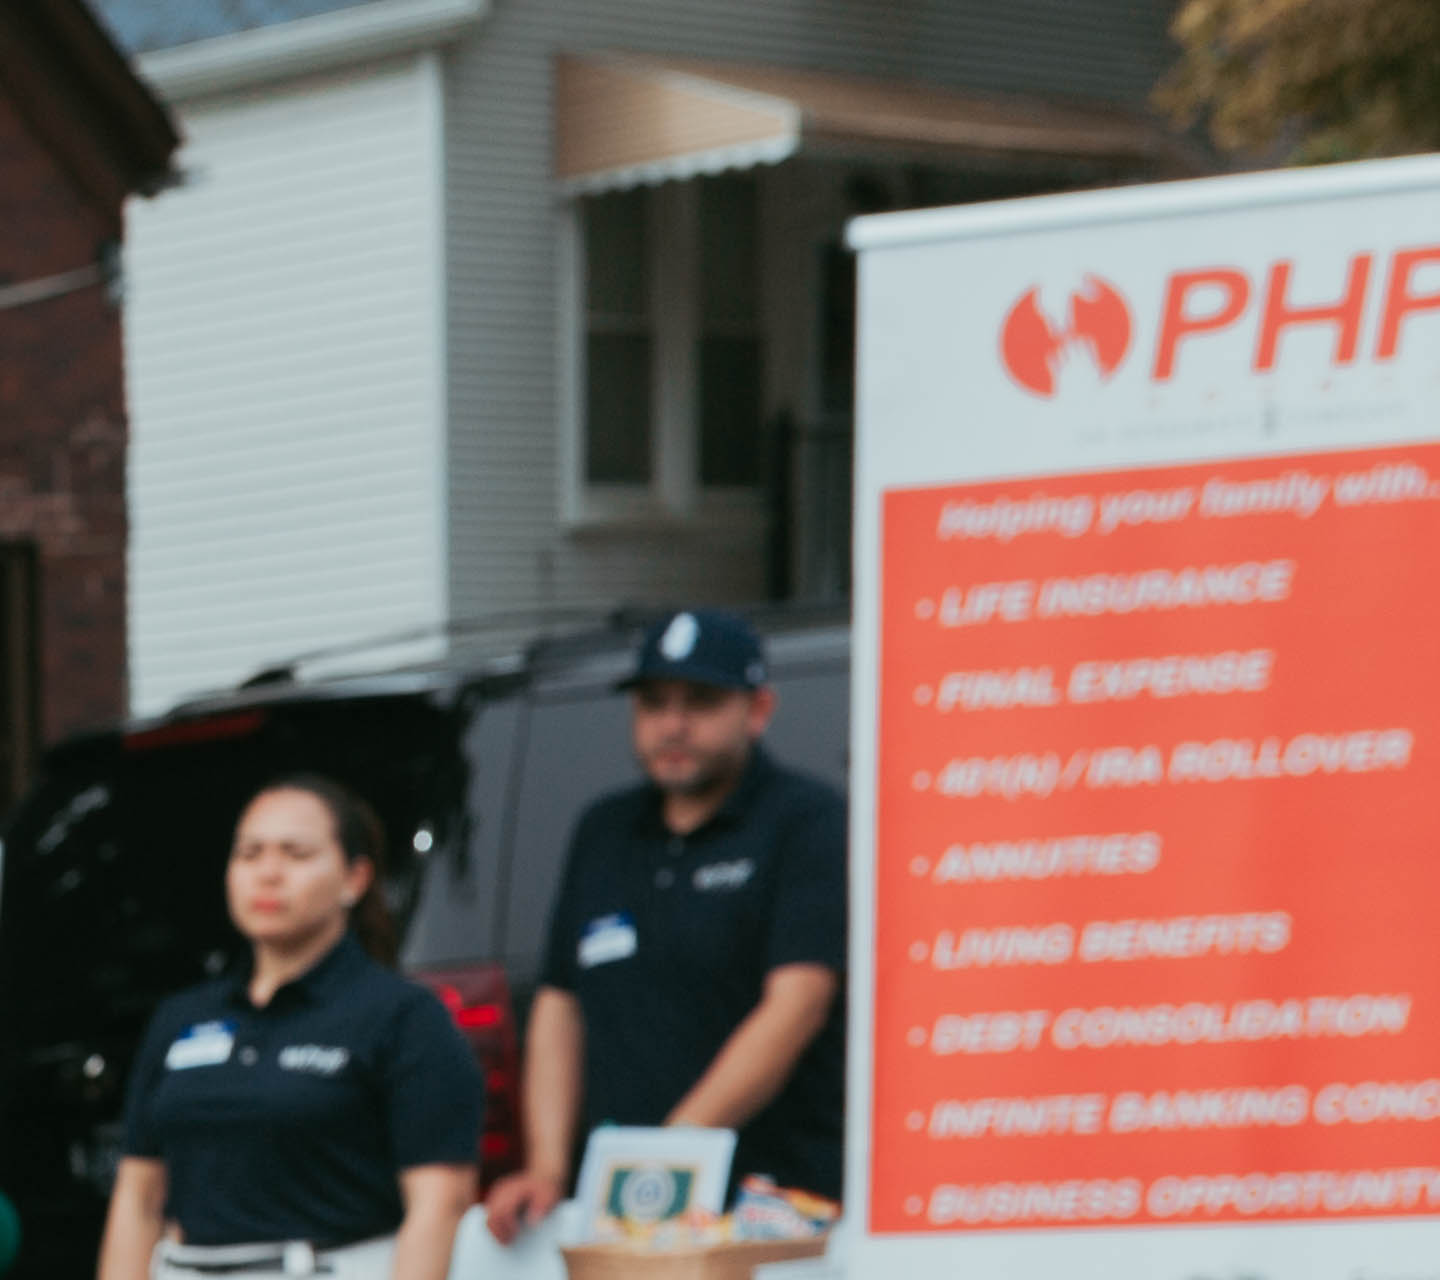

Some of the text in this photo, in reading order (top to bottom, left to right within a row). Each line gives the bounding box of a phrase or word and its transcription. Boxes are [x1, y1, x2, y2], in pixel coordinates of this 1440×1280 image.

[937, 464, 1328, 541] Helping your family
[937, 558, 1296, 628] LIFE INSURANCE
[935, 648, 1276, 714] FINAL EXPENSE
[1087, 745, 1163, 789] IRA
[1169, 727, 1414, 785] ROLLOVER
[933, 831, 1162, 884] ANNUITIES
[932, 910, 1292, 971] LIVING BENEFITS
[931, 993, 1413, 1056] DEBT CONSOLIDATION
[928, 1093, 1106, 1140] INFINITE
[1109, 1085, 1311, 1134] BANKING
[928, 1177, 1142, 1226] BUSINESS
